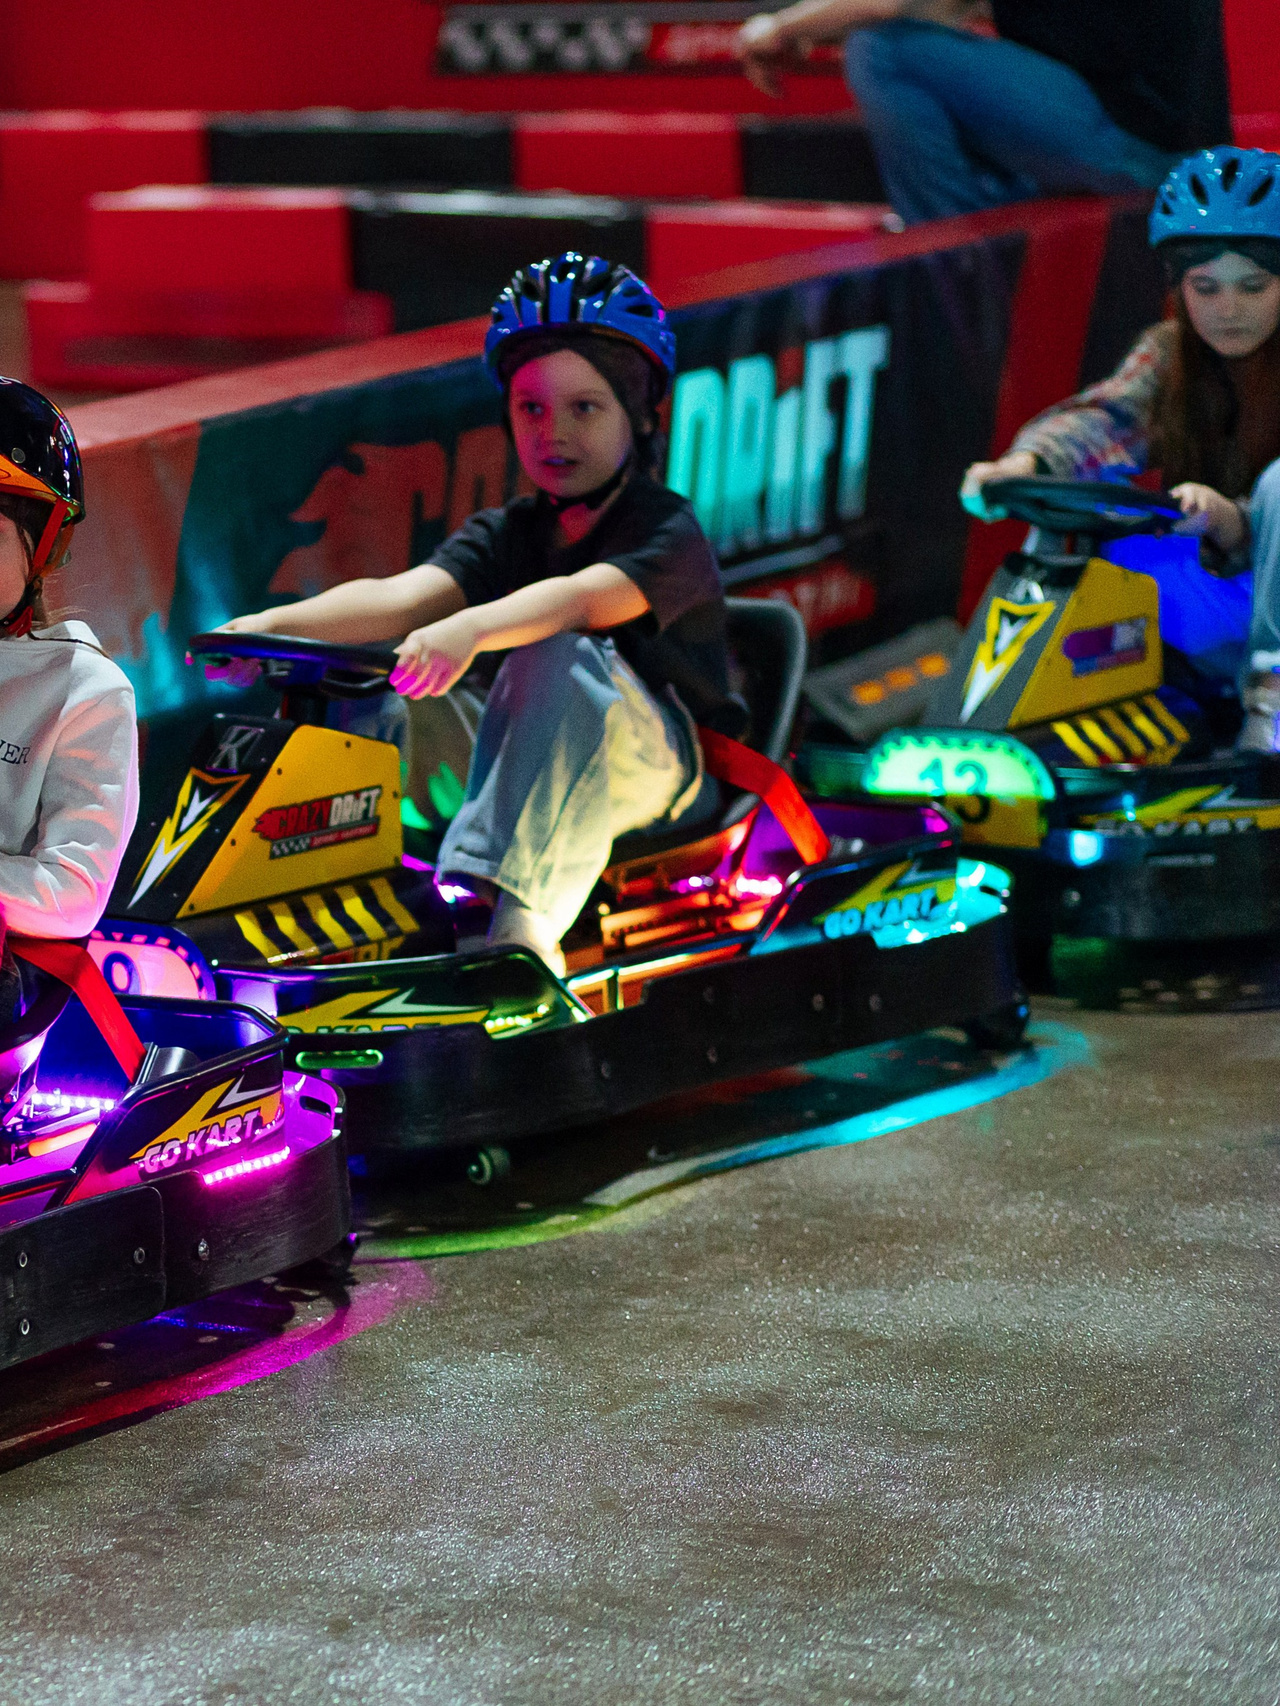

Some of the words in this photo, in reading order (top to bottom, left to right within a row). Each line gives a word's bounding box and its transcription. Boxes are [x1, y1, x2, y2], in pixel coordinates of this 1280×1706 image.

[919, 757, 992, 824] 13
[143, 1140, 181, 1174] GO
[185, 1109, 261, 1161] KART
